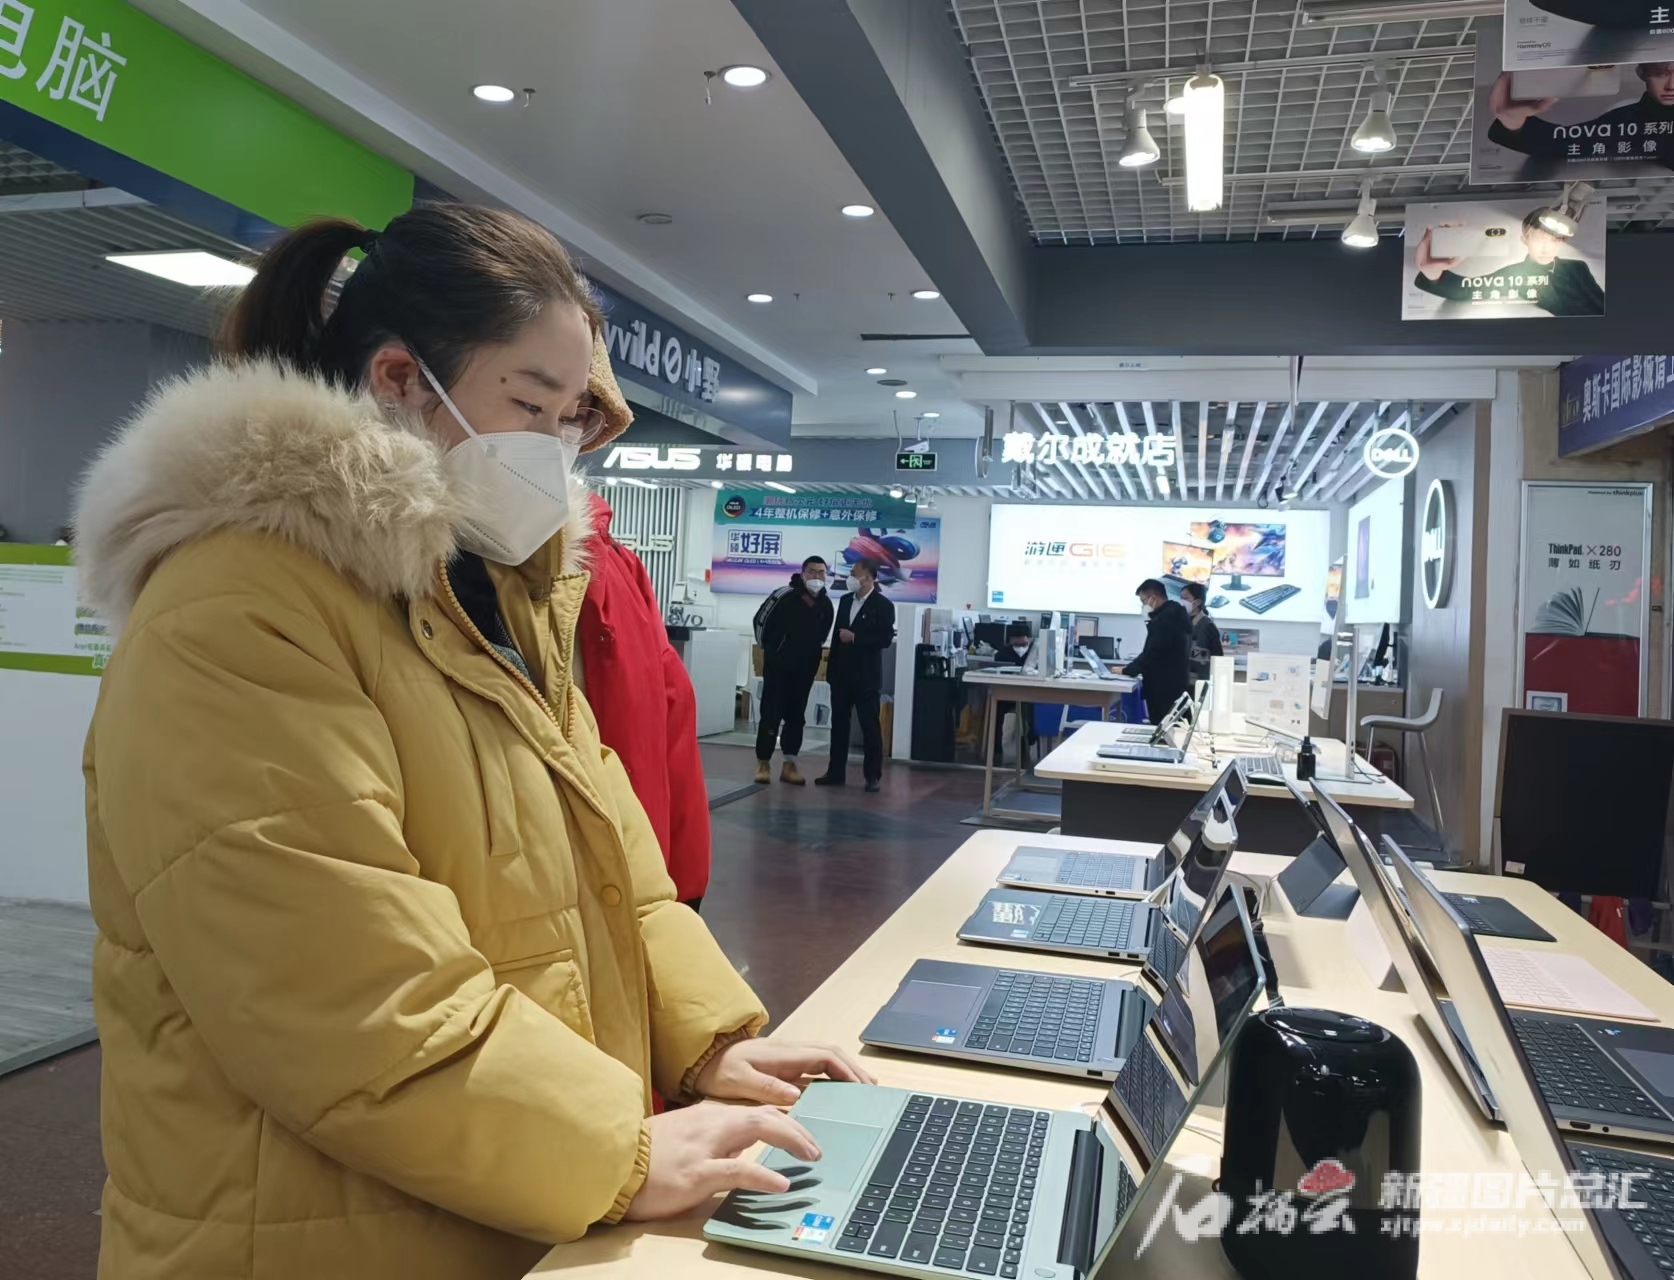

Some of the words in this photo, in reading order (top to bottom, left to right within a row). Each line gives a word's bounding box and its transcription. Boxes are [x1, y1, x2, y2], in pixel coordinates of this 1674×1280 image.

[1553, 123, 1612, 139] nova
[1617, 122, 1638, 137] 10
[1643, 120, 1674, 136] 系列
[1567, 139, 1658, 156] 主角影像
[1460, 276, 1505, 288] nova
[1508, 275, 1523, 287] 10
[1526, 274, 1549, 286] 系列
[1001, 432, 1177, 467] 戴尔成就店
[603, 447, 701, 470] ASUS
[715, 453, 793, 472] 华硕电脑
[754, 508, 877, 522] 4年整机保修+意外保修
[730, 532, 741, 553] 华硕
[740, 532, 781, 554] 好屏
[1548, 543, 1583, 556] ThinkPad
[1548, 557, 1621, 570] 薄如纸刃
